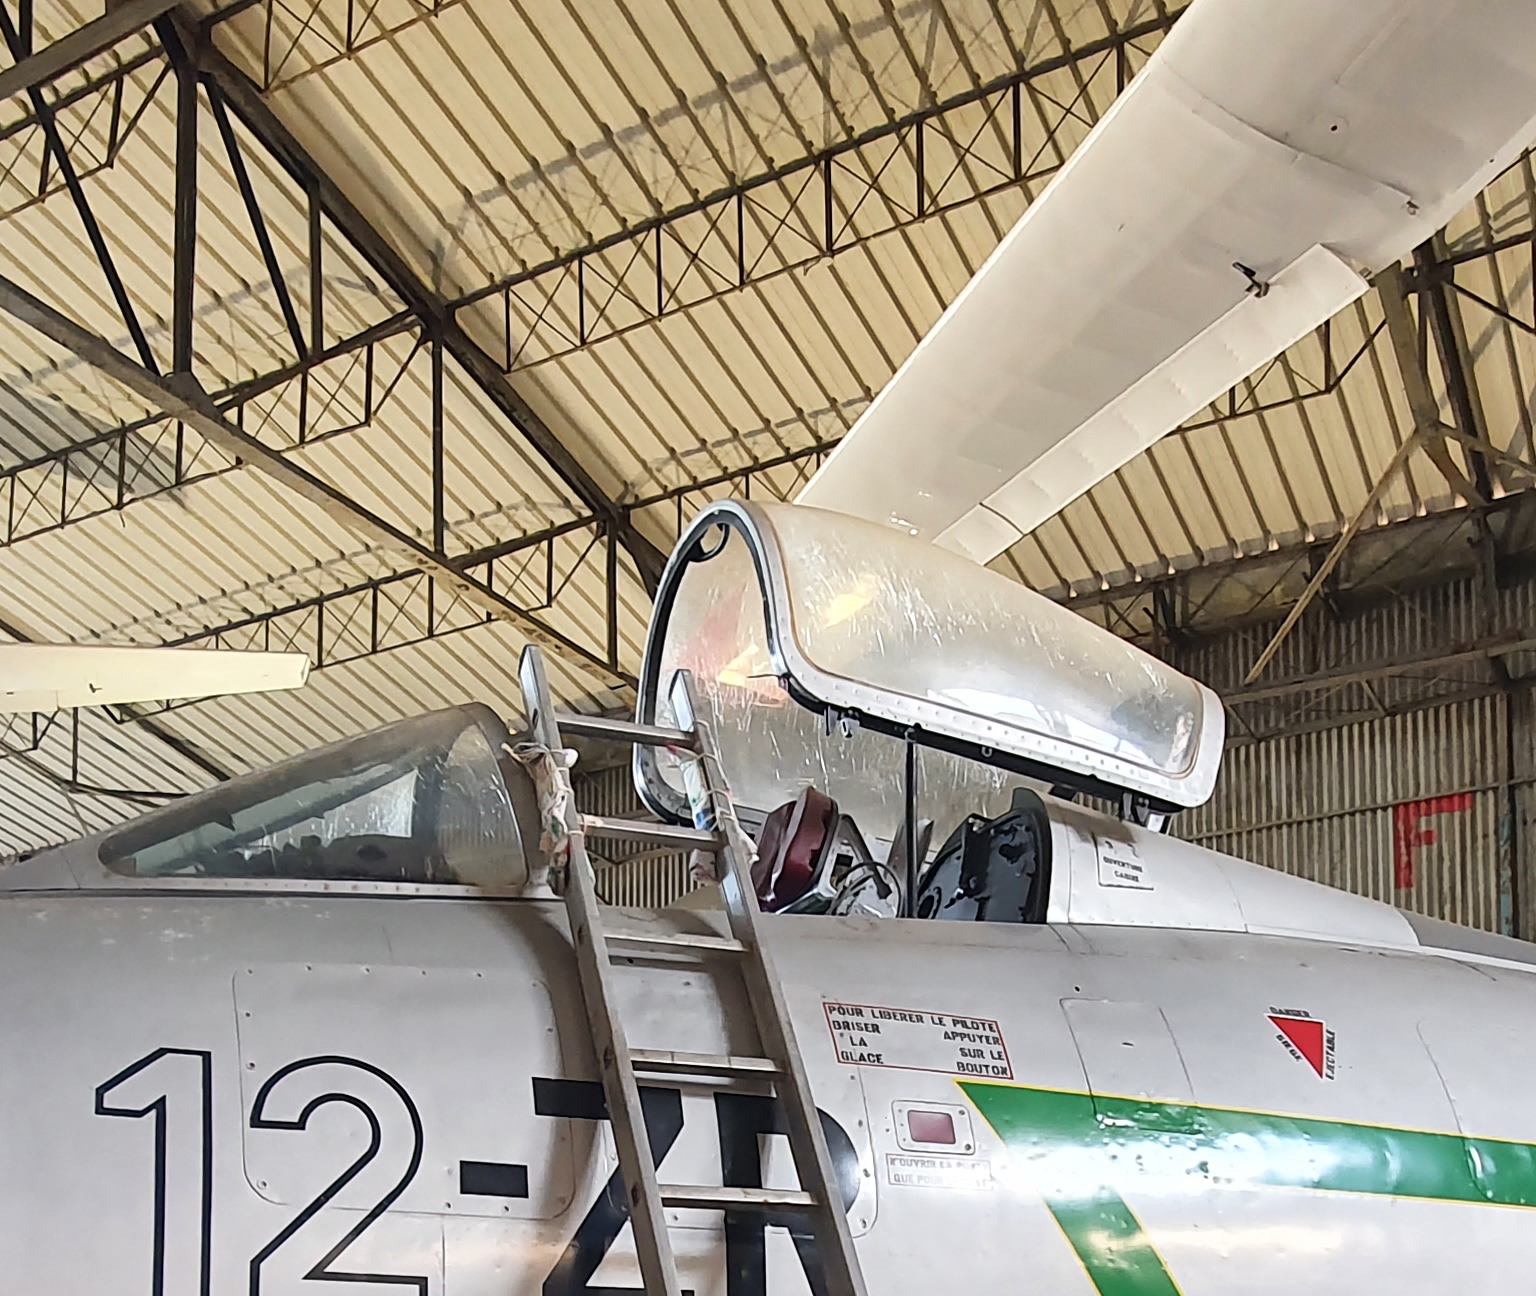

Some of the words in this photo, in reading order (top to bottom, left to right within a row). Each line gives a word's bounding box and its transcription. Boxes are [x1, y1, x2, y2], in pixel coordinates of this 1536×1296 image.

[828, 1005, 864, 1018] POUR
[871, 1009, 924, 1024] LIBERER
[931, 1016, 946, 1027] LE
[953, 1019, 997, 1033] PILOTE
[832, 1020, 881, 1034] BRISER
[849, 1035, 868, 1047] LA
[944, 1030, 1001, 1046] APPUYER
[841, 1051, 884, 1064] GLACE
[960, 1048, 985, 1060] SUR
[990, 1050, 1005, 1061] LE
[957, 1062, 1008, 1076] BOUTON
